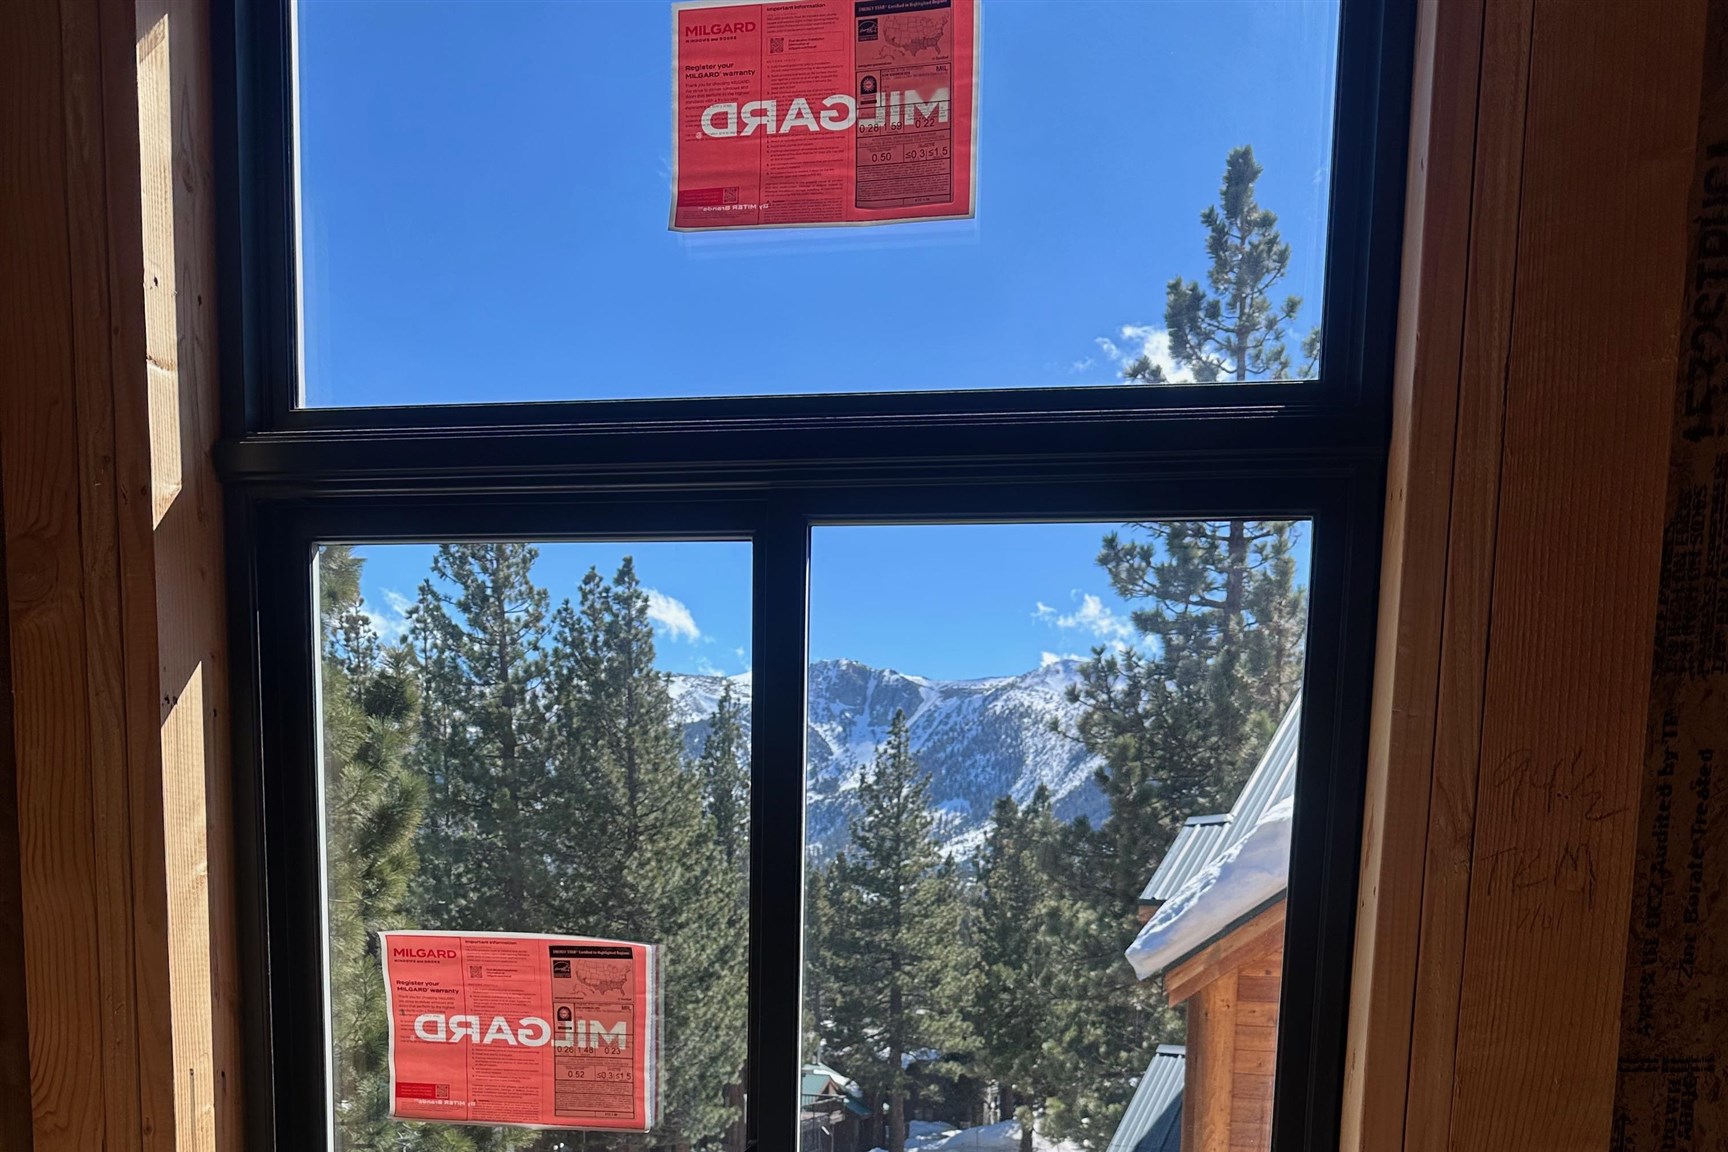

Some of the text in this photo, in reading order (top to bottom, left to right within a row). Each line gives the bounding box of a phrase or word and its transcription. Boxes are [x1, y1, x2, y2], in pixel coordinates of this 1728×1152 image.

[686, 22, 756, 37] MILGARD
[723, 69, 755, 77] warranty
[1656, 745, 1679, 777] by
[1690, 748, 1714, 841] Treated
[1649, 783, 1673, 877] Audited
[394, 948, 456, 958] MILGARD
[1662, 1079, 1682, 1149] DOWN
